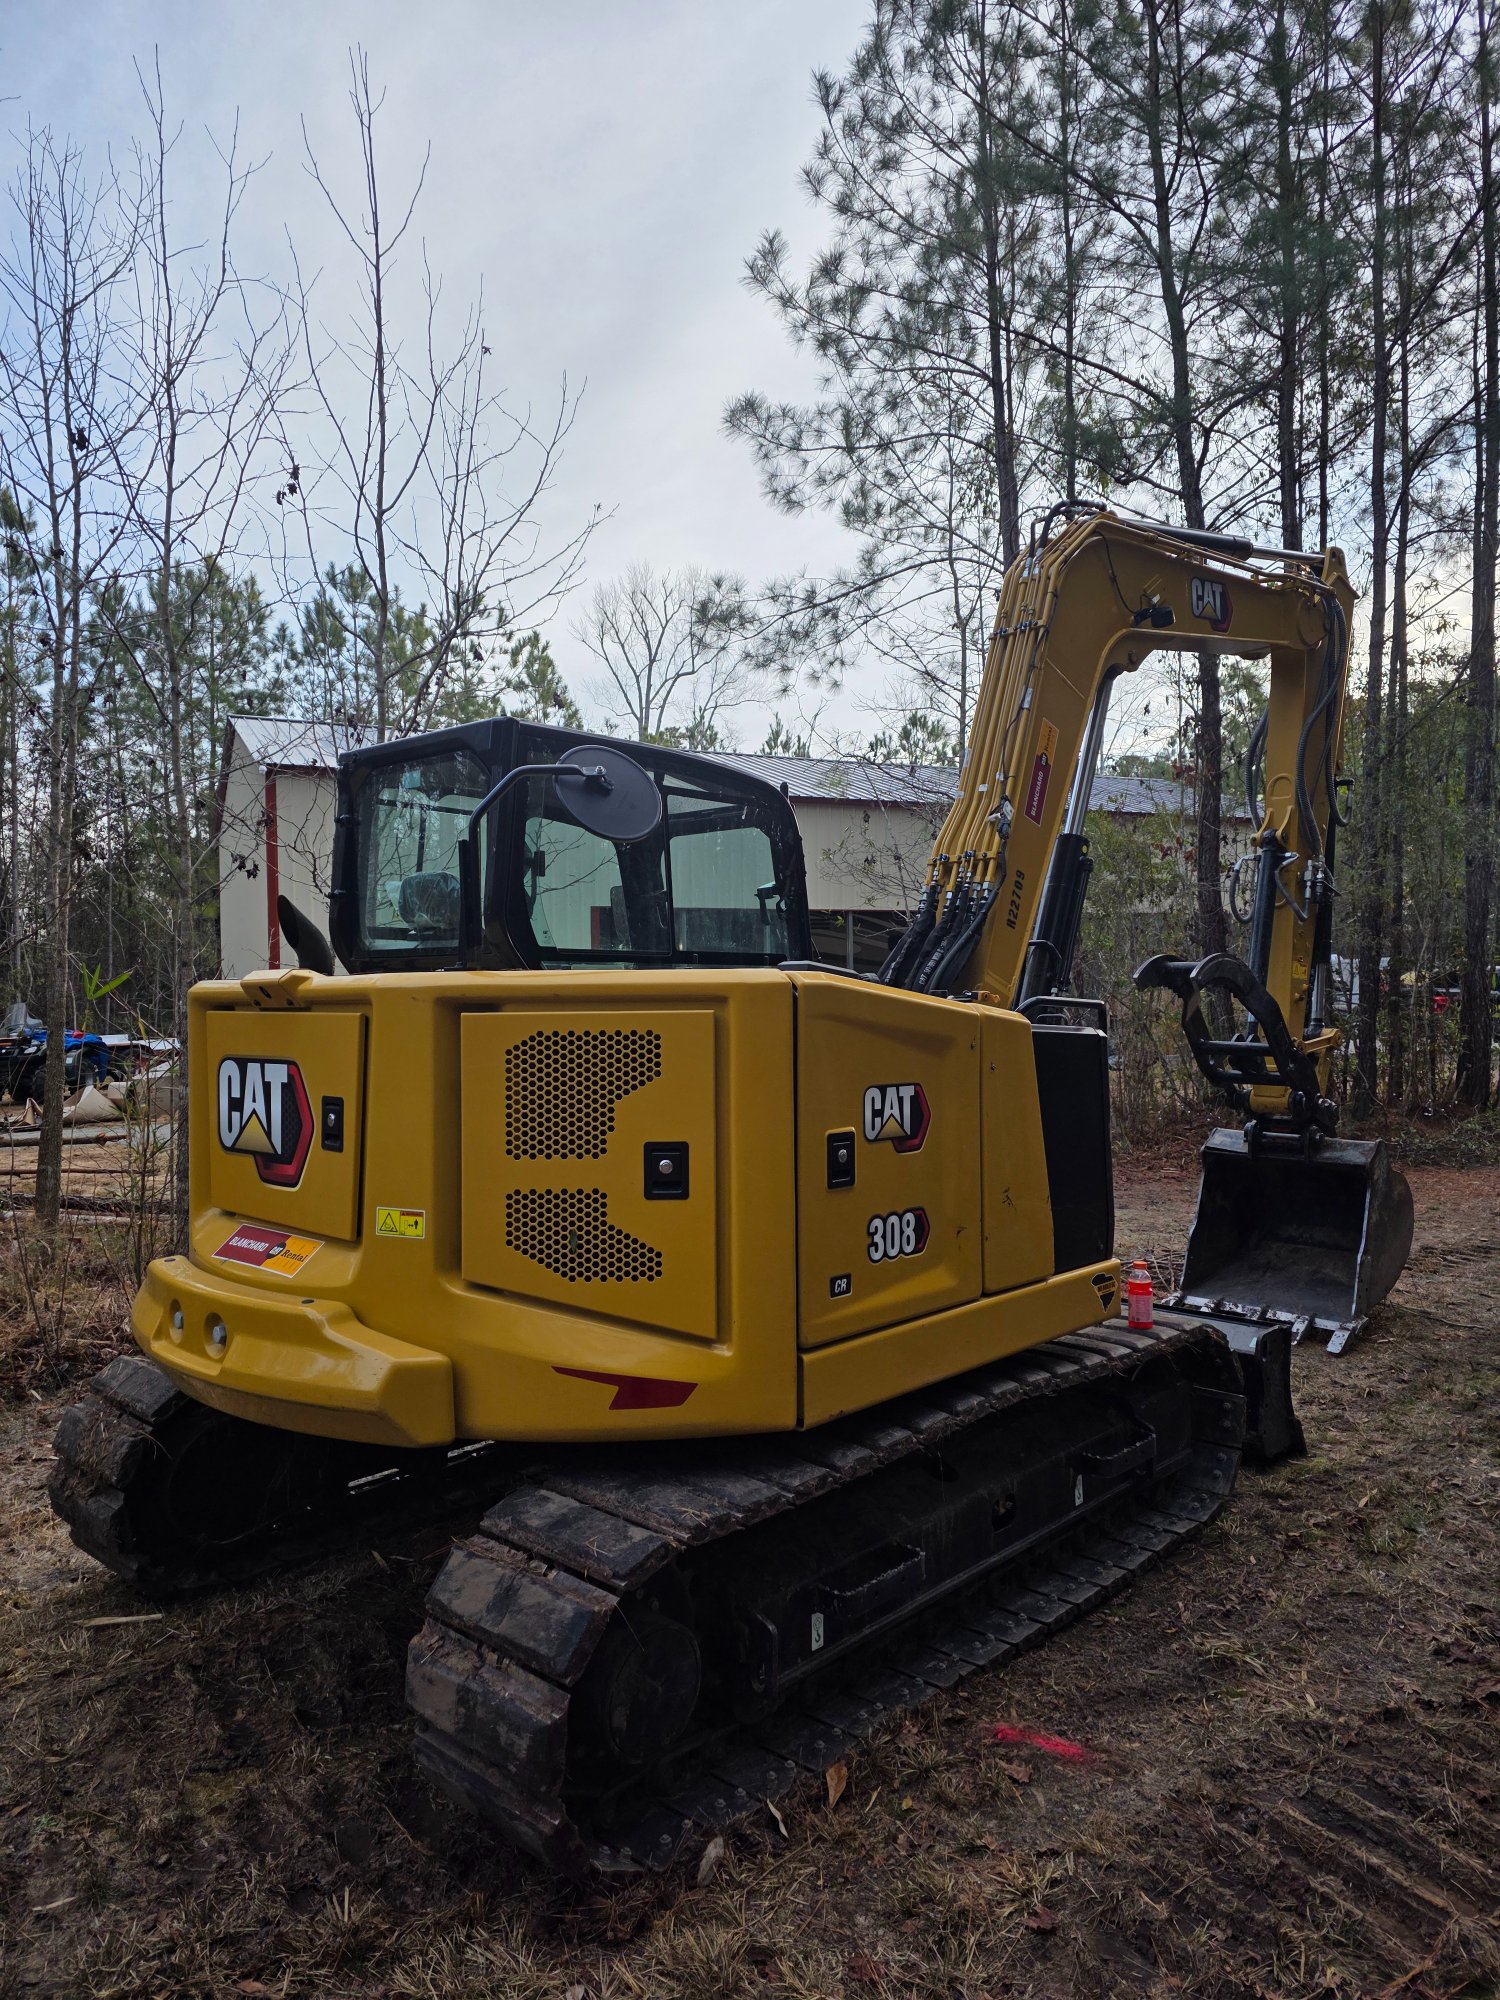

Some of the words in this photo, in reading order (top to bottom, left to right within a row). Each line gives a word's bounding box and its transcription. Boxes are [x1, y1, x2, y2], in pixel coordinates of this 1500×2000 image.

[1191, 577, 1223, 621] CAT
[1030, 771, 1044, 816] BLANCHARD
[218, 1059, 288, 1155] CAT
[864, 1085, 915, 1140] CAT
[229, 1236, 269, 1252] BLANCHARD
[281, 1249, 309, 1263] Rental
[869, 1212, 917, 1262] 308
[834, 1279, 847, 1292] CR
